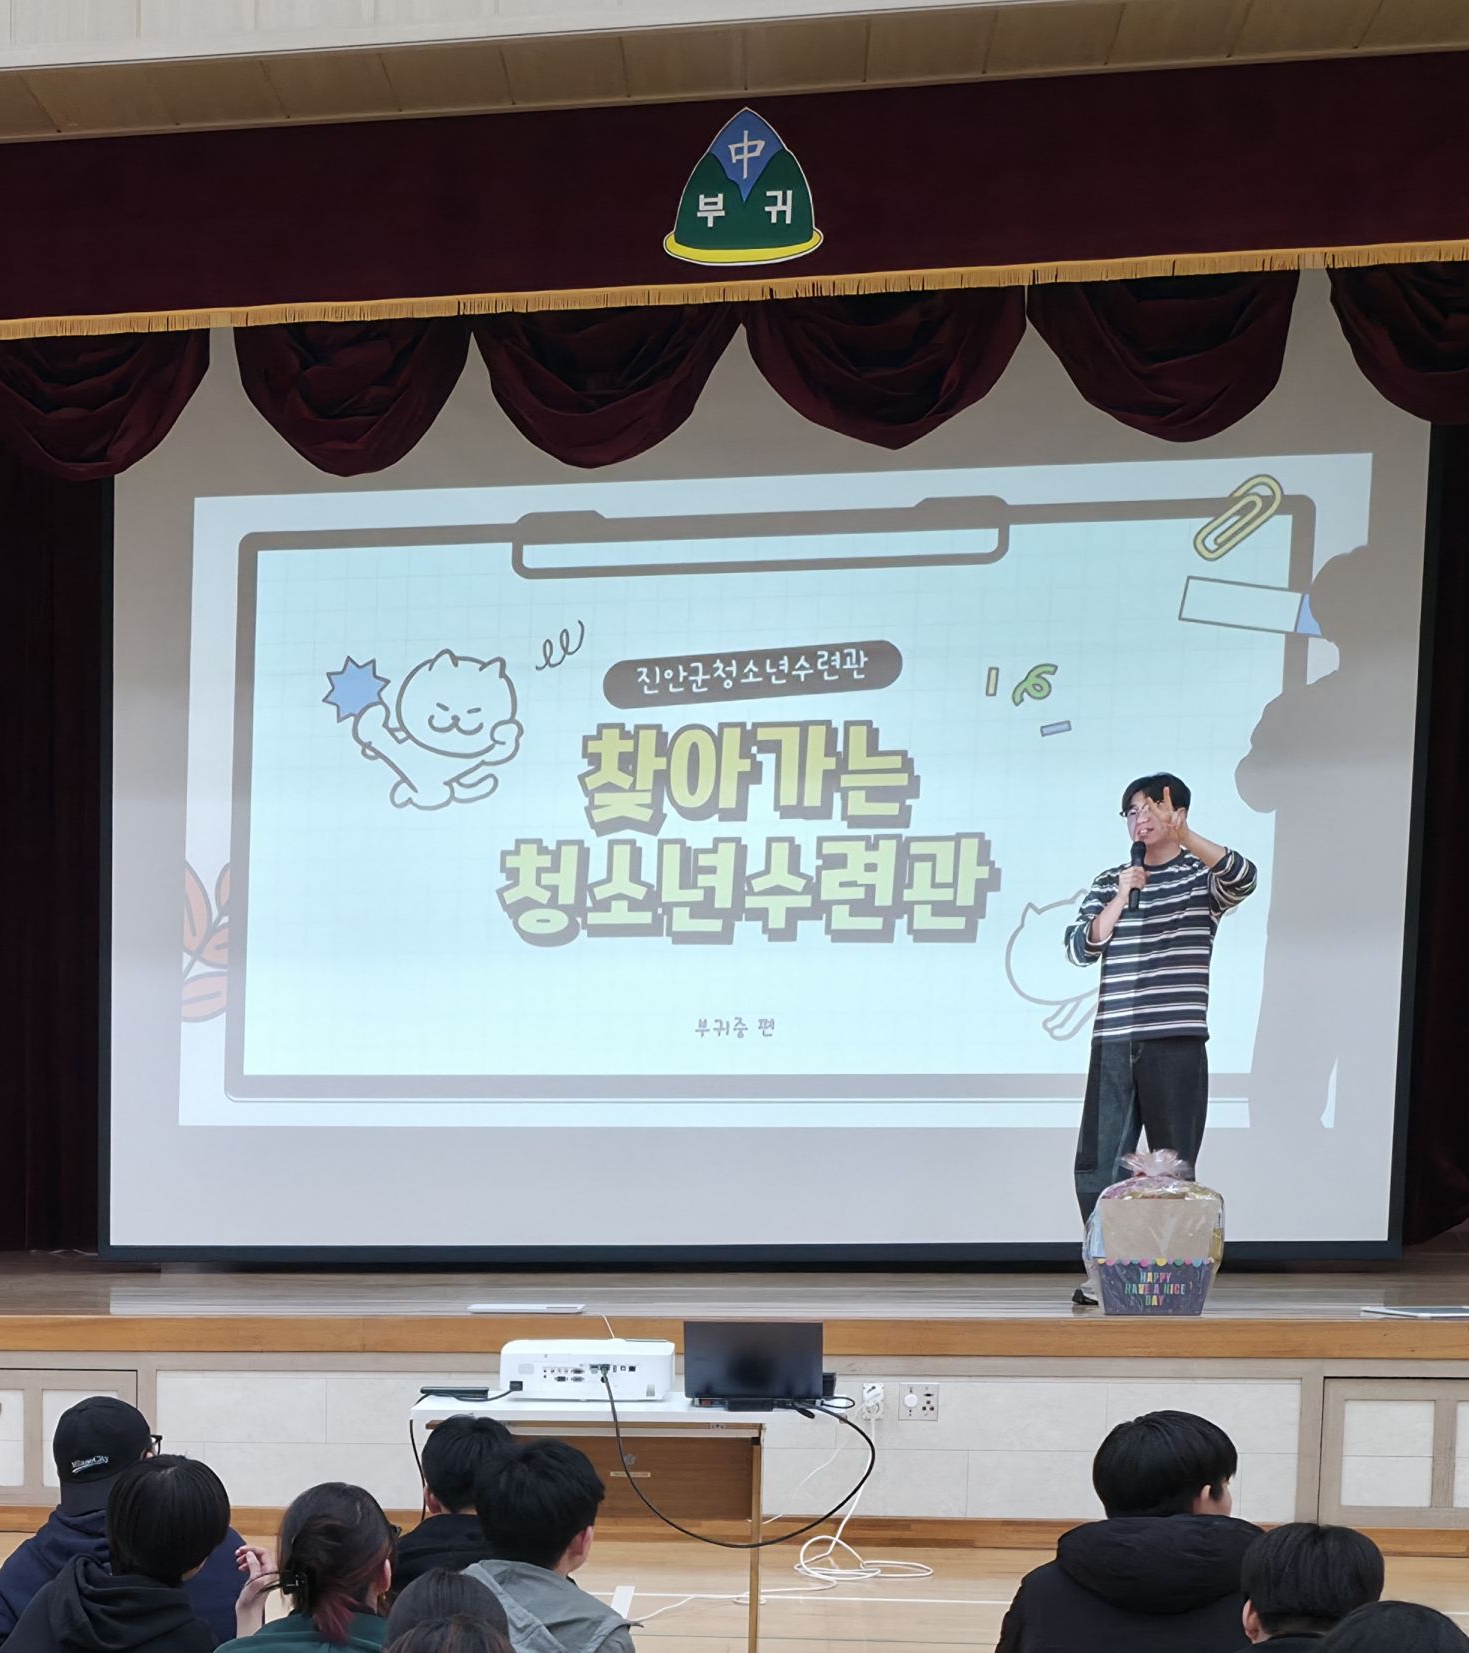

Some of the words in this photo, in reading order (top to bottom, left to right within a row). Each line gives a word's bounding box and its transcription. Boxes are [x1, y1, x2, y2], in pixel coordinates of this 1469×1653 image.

[728, 130, 766, 180] 中
[636, 648, 869, 694] 진안군청소년수련관
[579, 720, 920, 835] 찾아가는
[498, 832, 1000, 945] 청소년수련관
[694, 1016, 749, 1039] 부귀중
[757, 1018, 775, 1037] 편
[1125, 1283, 1150, 1295] HAVE
[1153, 1283, 1160, 1295] A
[1163, 1283, 1185, 1295] NICE
[1139, 1271, 1172, 1283] HAPPY
[1145, 1295, 1164, 1306] DAY
